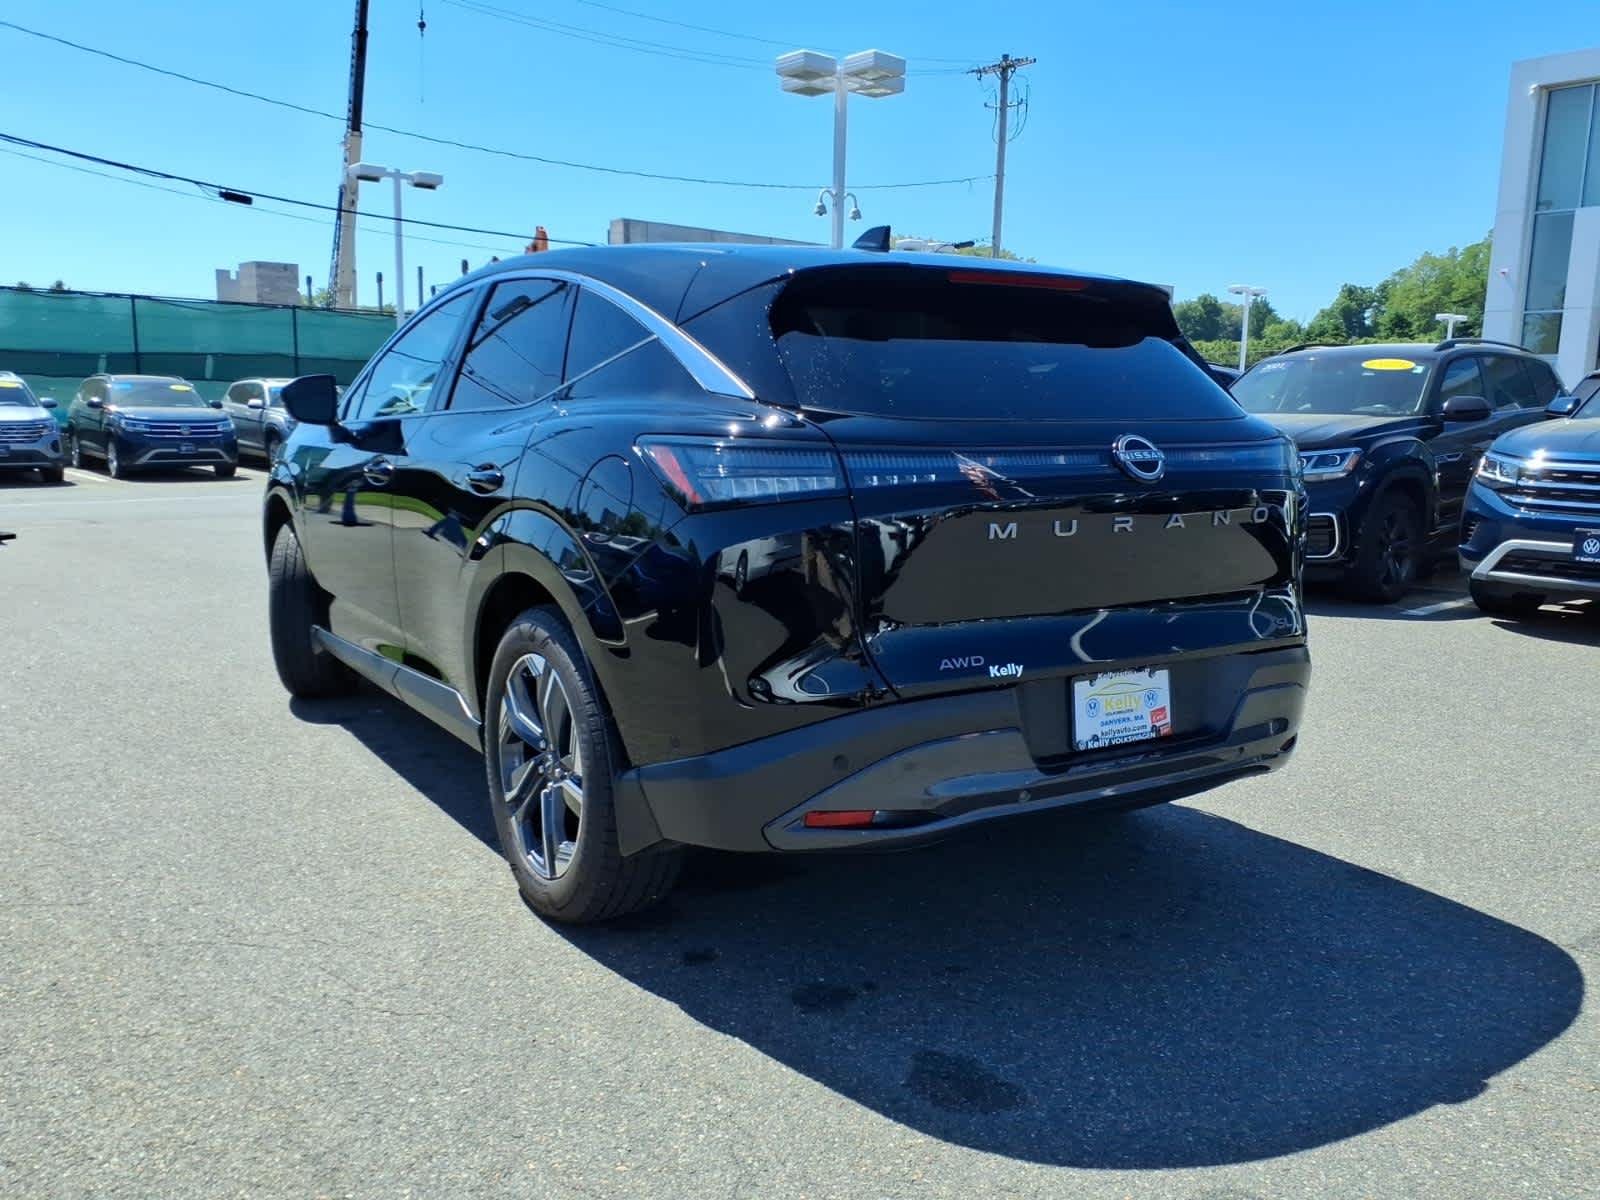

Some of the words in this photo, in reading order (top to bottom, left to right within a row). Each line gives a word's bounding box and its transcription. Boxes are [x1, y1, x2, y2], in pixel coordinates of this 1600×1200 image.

[988, 507, 1269, 540] MURANO
[939, 655, 985, 671] AWD
[988, 663, 1024, 678] Kelly
[1104, 694, 1141, 711] Kelly
[1100, 724, 1148, 737] kellyauto.com
[1087, 738, 1110, 749] Kelly
